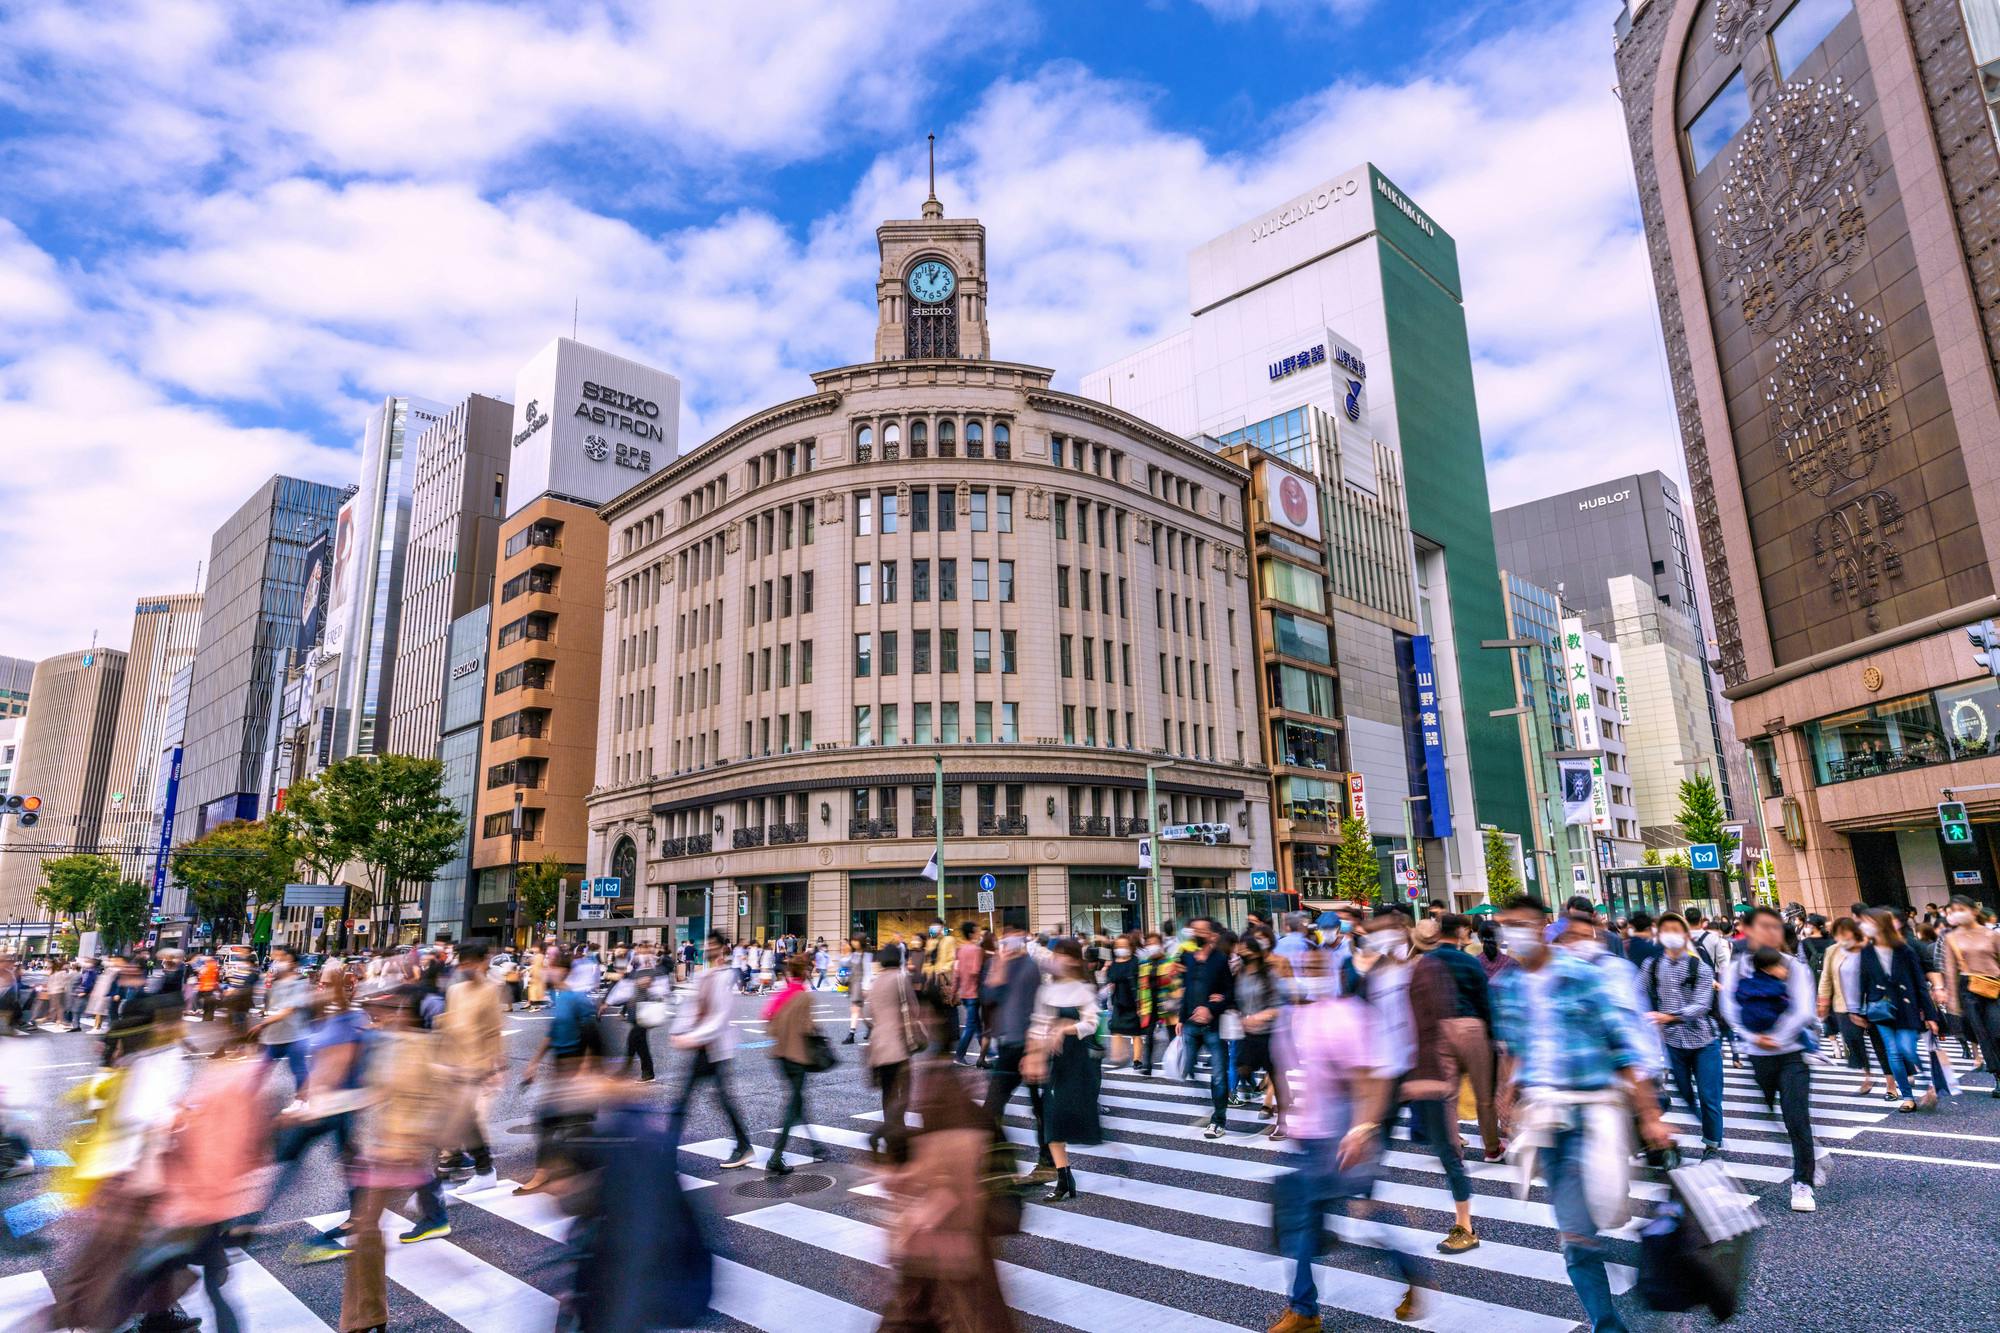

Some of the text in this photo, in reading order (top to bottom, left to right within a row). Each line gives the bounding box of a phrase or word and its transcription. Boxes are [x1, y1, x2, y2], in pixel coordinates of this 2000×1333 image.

[1250, 179, 1359, 243] MIKIMOTO
[1377, 178, 1434, 238] MIKIMOTO
[915, 285, 922, 293] 8
[928, 292, 935, 300] 6
[936, 290, 942, 298] 5
[912, 307, 951, 316] SEIKO
[1268, 344, 1325, 382] 山野楽器
[1333, 344, 1367, 379] 山野楽器
[582, 381, 659, 419] SEIKO
[415, 411, 441, 423] TENS
[574, 402, 663, 442] ASTRON
[615, 442, 651, 463] GPS
[615, 456, 650, 472] SOLAR
[1579, 490, 1630, 511] HUBLOT
[326, 624, 343, 645] FRED
[453, 658, 479, 680] SEIKO
[1567, 632, 1591, 710] 教文館
[1418, 672, 1439, 746] 山野楽器
